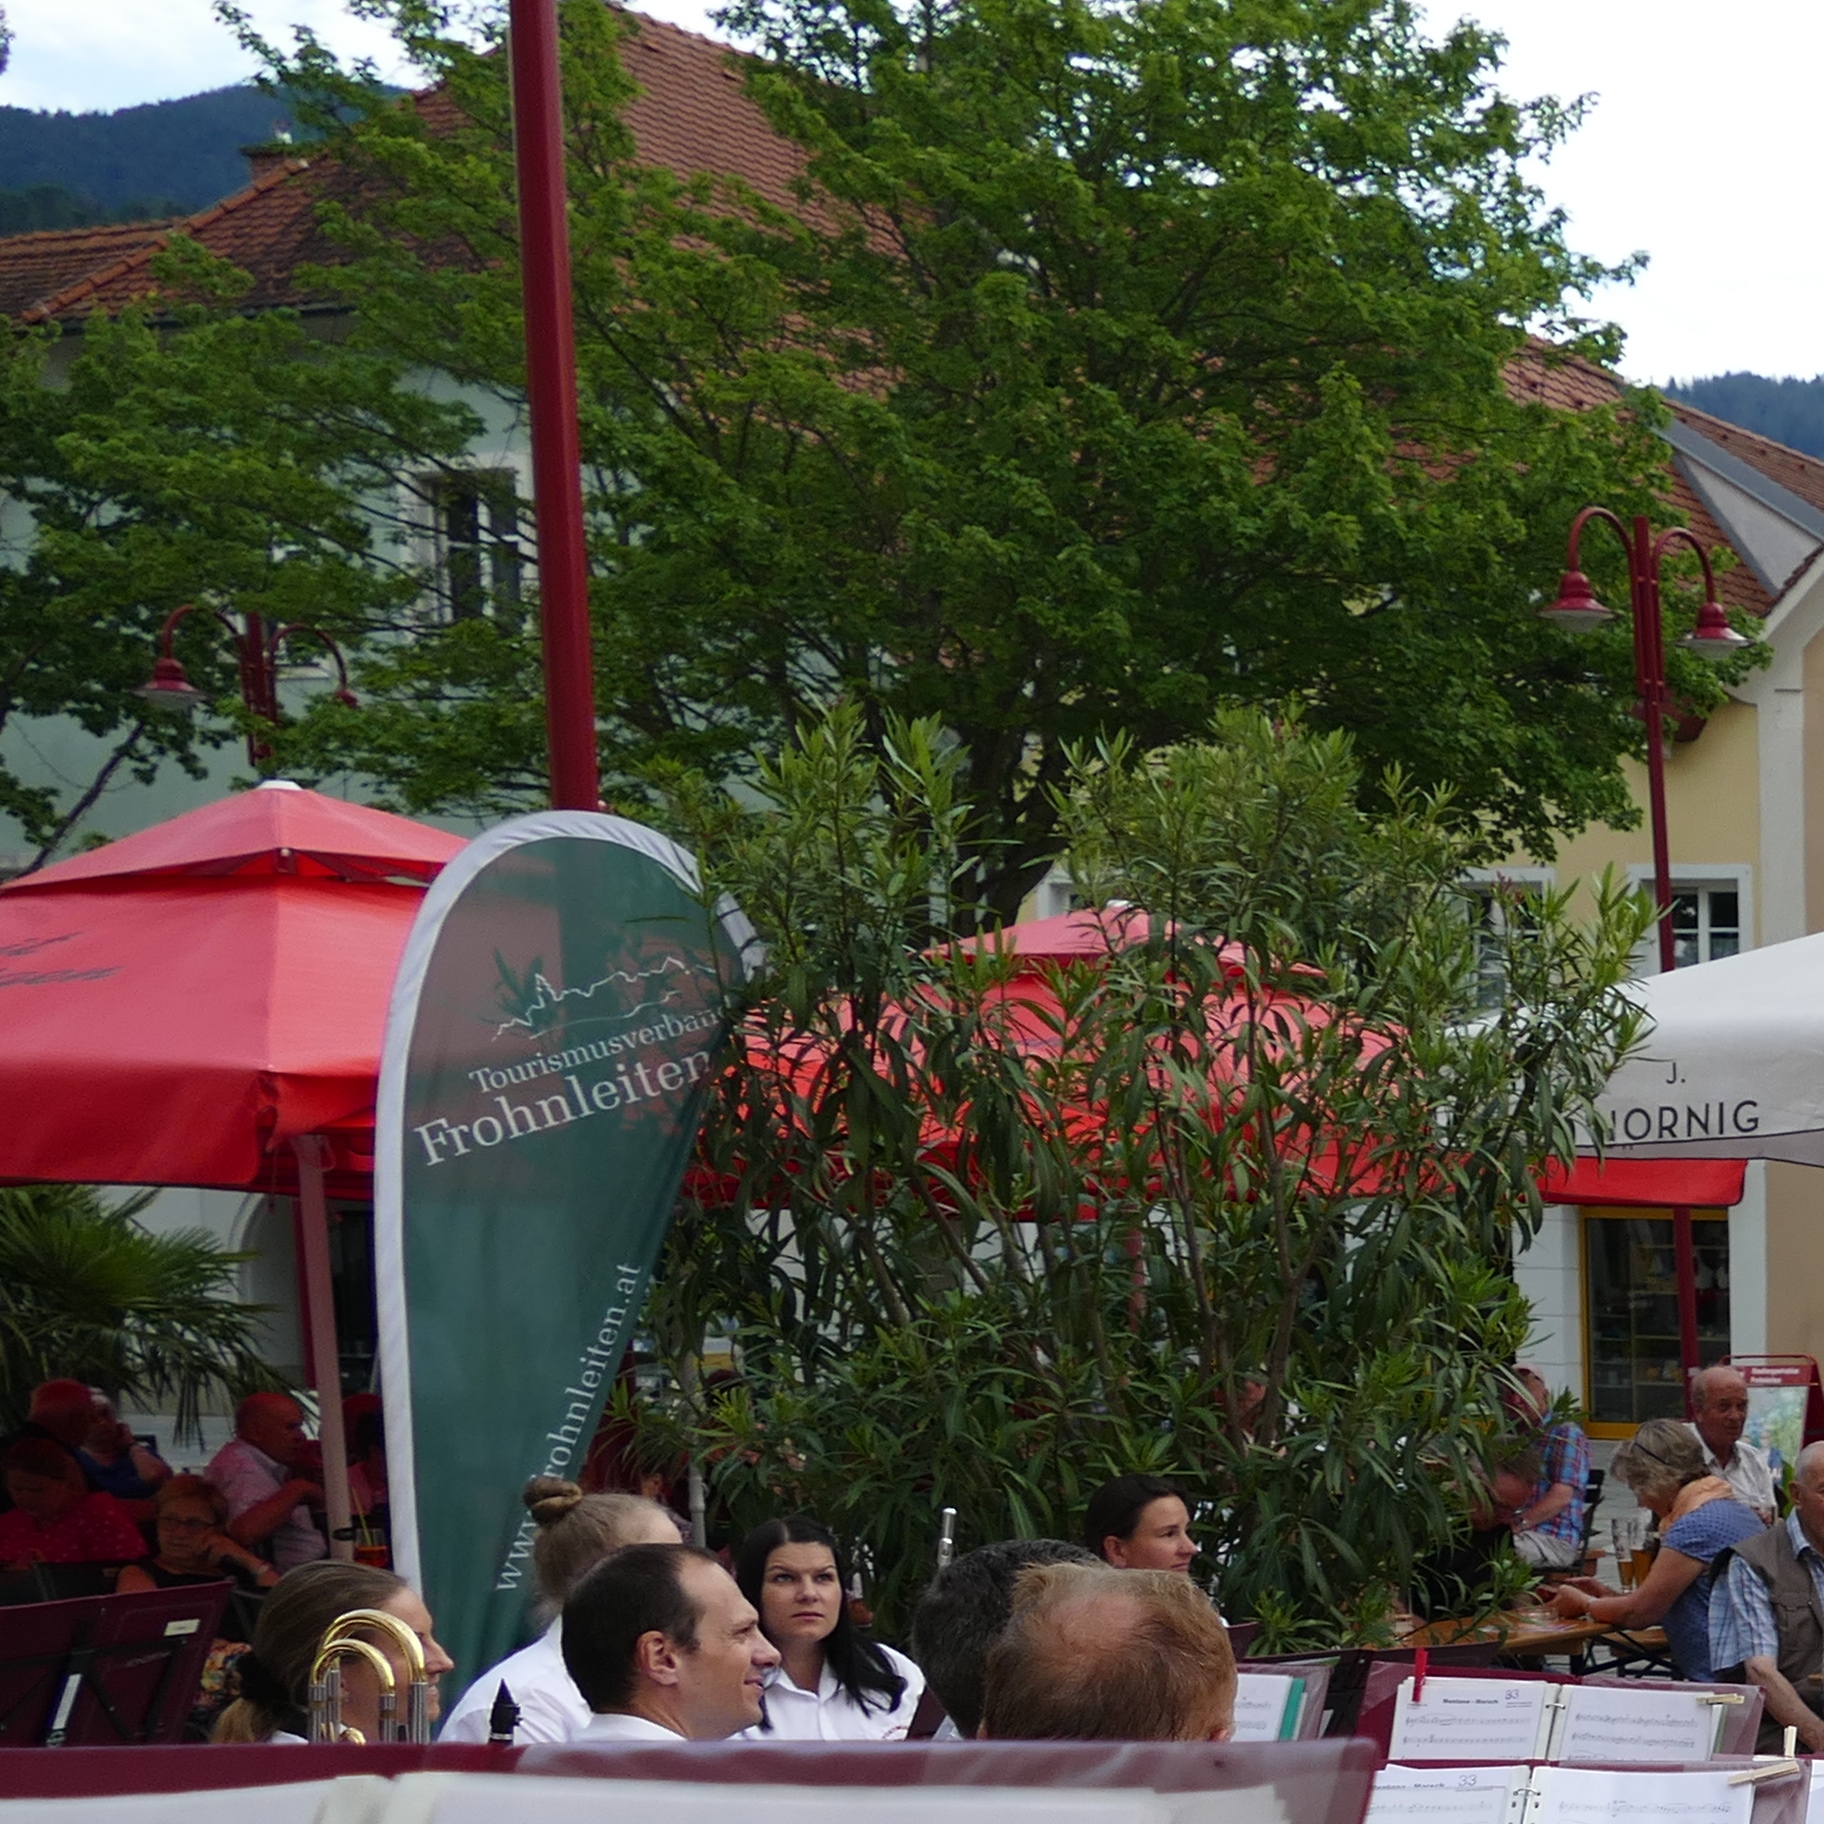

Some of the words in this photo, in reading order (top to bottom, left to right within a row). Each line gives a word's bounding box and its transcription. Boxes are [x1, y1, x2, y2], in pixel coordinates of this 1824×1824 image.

[1666, 1062, 1686, 1085] J.
[414, 1049, 712, 1167] Frohnleiten
[1458, 1775, 1477, 1786] 33
